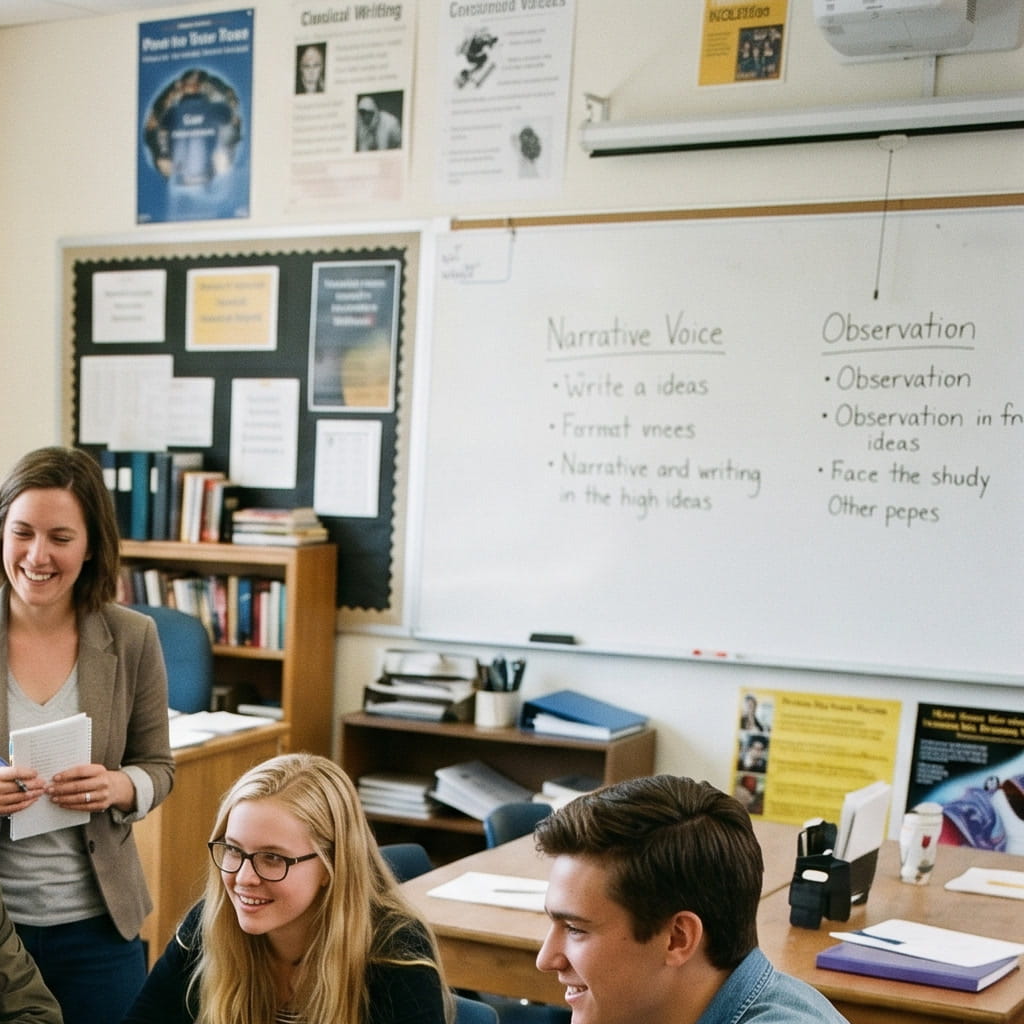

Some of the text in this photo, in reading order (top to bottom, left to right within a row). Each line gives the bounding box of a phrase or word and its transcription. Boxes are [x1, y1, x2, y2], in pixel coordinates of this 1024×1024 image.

[547, 310, 724, 350] Narrative Voice
[822, 311, 976, 344] Observation
[634, 381, 646, 396] a
[657, 372, 709, 396] ideas
[837, 364, 971, 390] Observation
[835, 402, 963, 427] Observation
[976, 408, 992, 426] in
[867, 431, 921, 451] ideas
[560, 452, 762, 499] Narrative and writing
[831, 459, 879, 483] Face
[888, 462, 921, 485] the
[585, 484, 611, 506] the
[620, 486, 660, 521] high
[666, 489, 713, 511] ideas
[827, 494, 877, 517] Other
